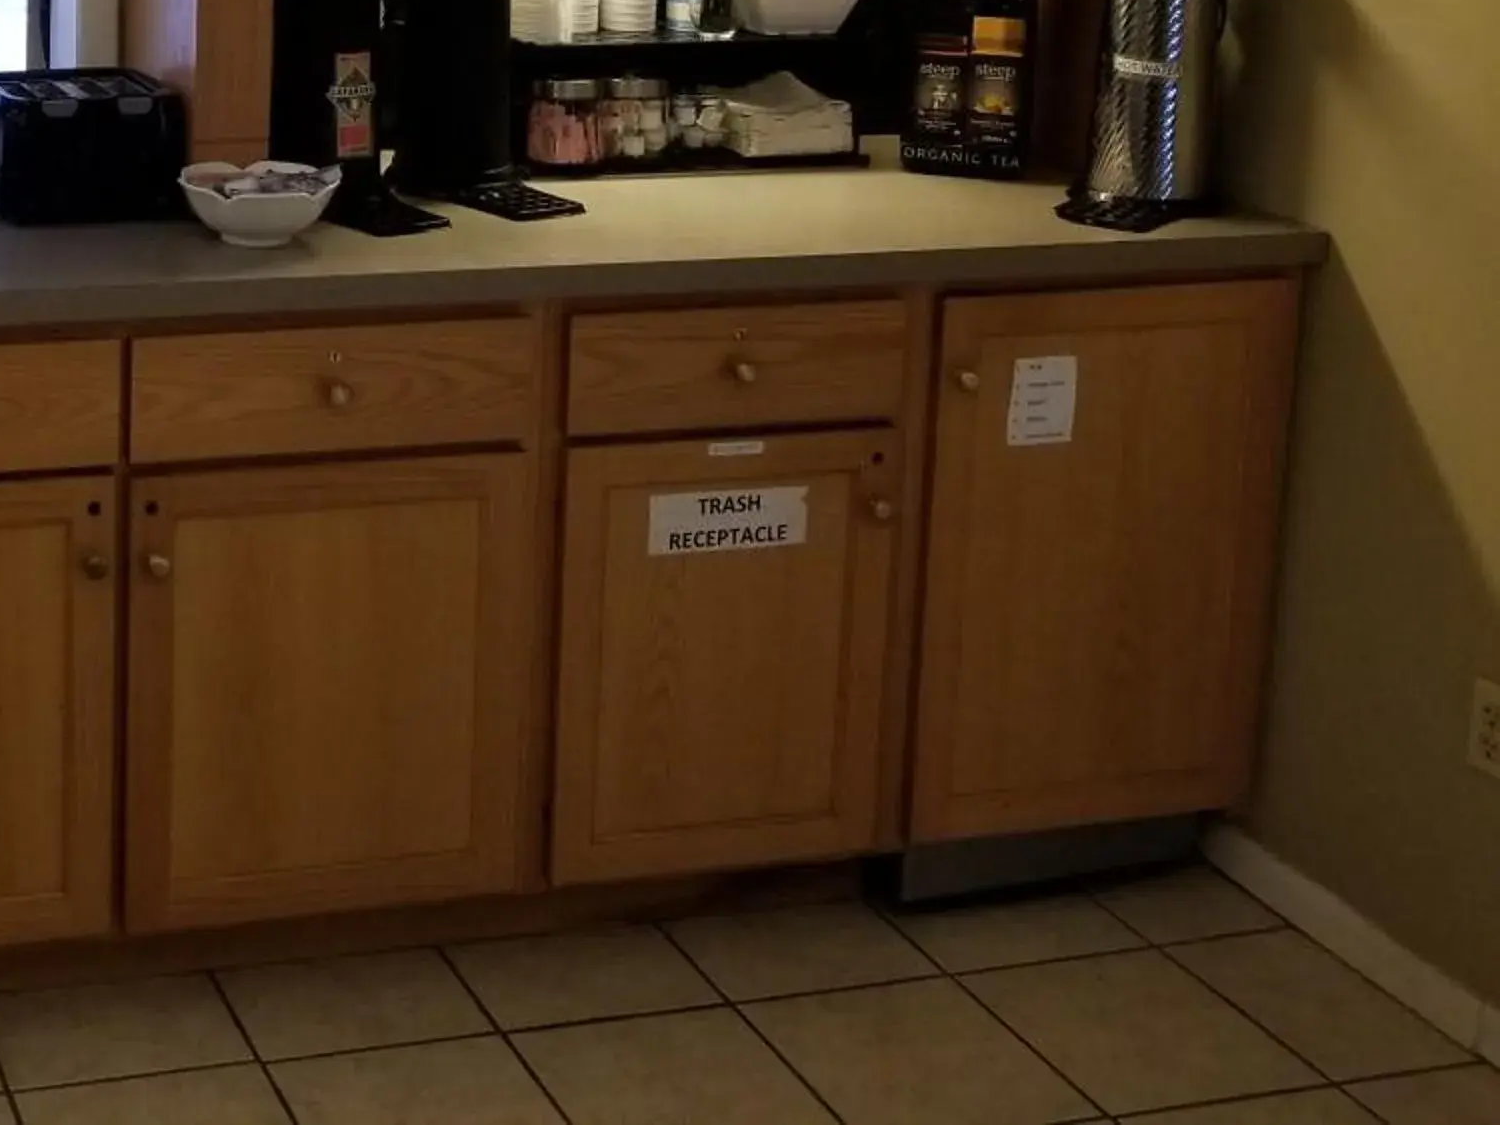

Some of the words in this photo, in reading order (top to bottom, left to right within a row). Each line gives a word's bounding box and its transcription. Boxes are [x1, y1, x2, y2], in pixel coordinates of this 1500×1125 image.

[920, 61, 961, 79] steep
[975, 62, 1017, 81] steep
[902, 145, 981, 165] ORGANIC
[991, 154, 1020, 168] TEA
[697, 494, 762, 517] TRASH
[668, 524, 788, 551] RECEPTACLE
